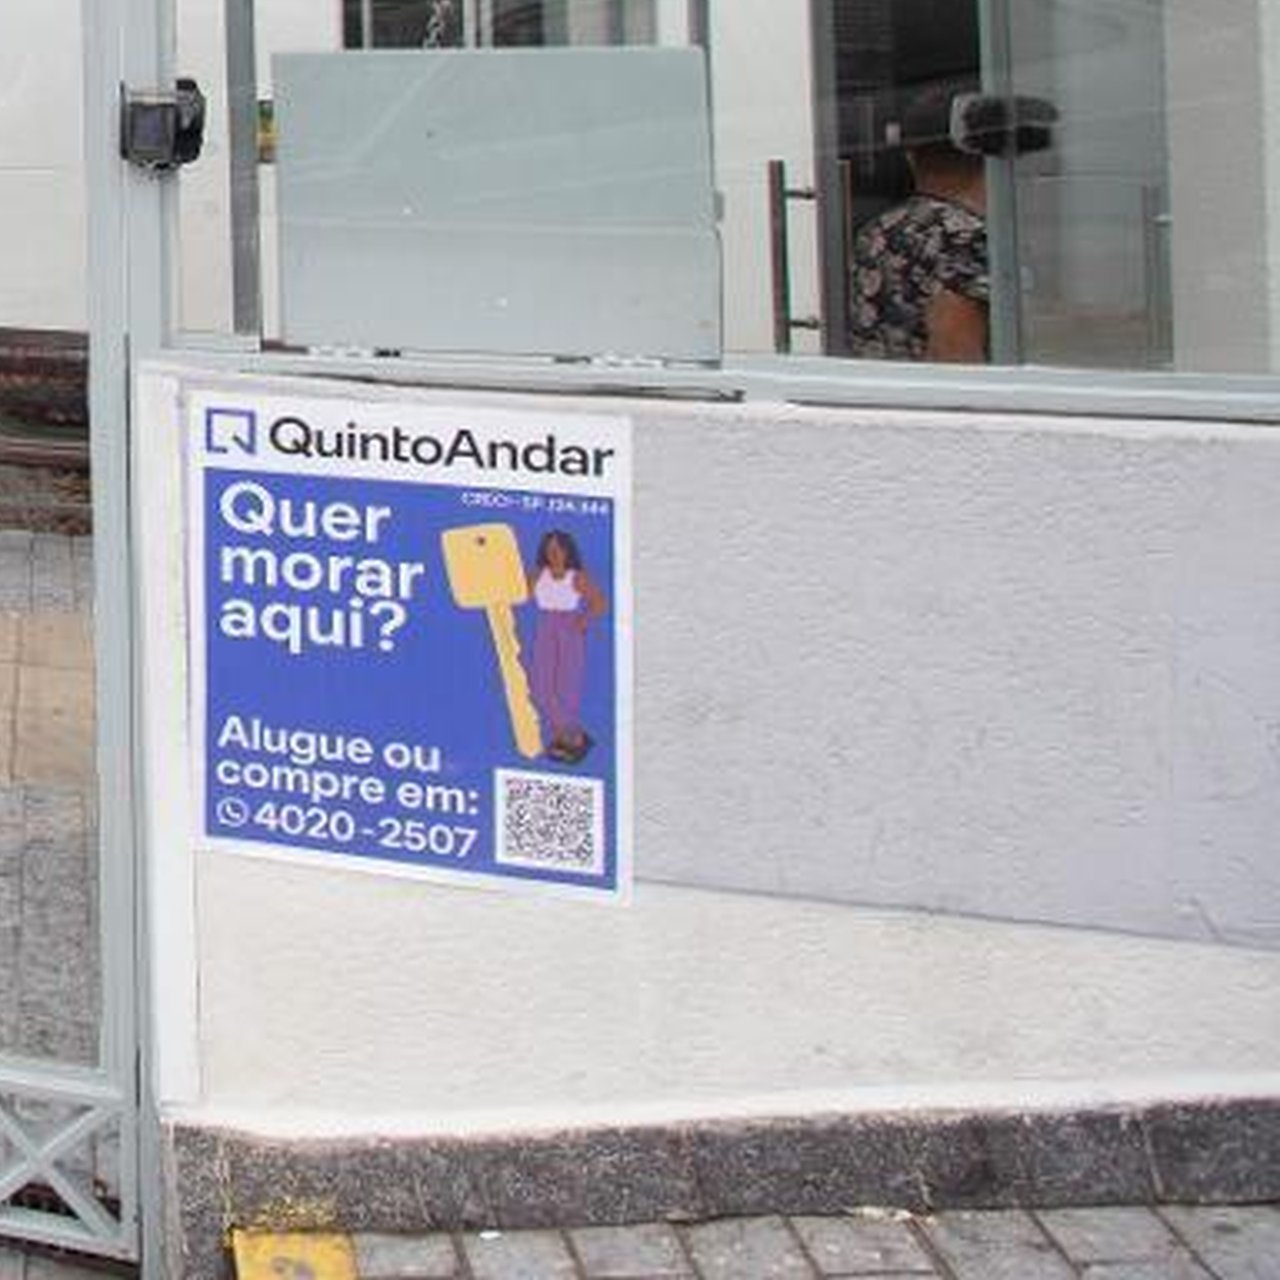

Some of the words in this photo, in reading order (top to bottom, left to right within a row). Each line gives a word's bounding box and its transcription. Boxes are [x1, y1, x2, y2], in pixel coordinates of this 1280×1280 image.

[269, 416, 615, 477] QuintoAndar
[219, 480, 391, 543] Quer
[220, 545, 425, 600] morar
[219, 596, 407, 655] aqui?
[217, 715, 374, 765] Alugue
[383, 742, 441, 772] ou
[216, 759, 386, 803] compre
[397, 781, 480, 816] em:
[253, 801, 479, 859] 4020-2507
